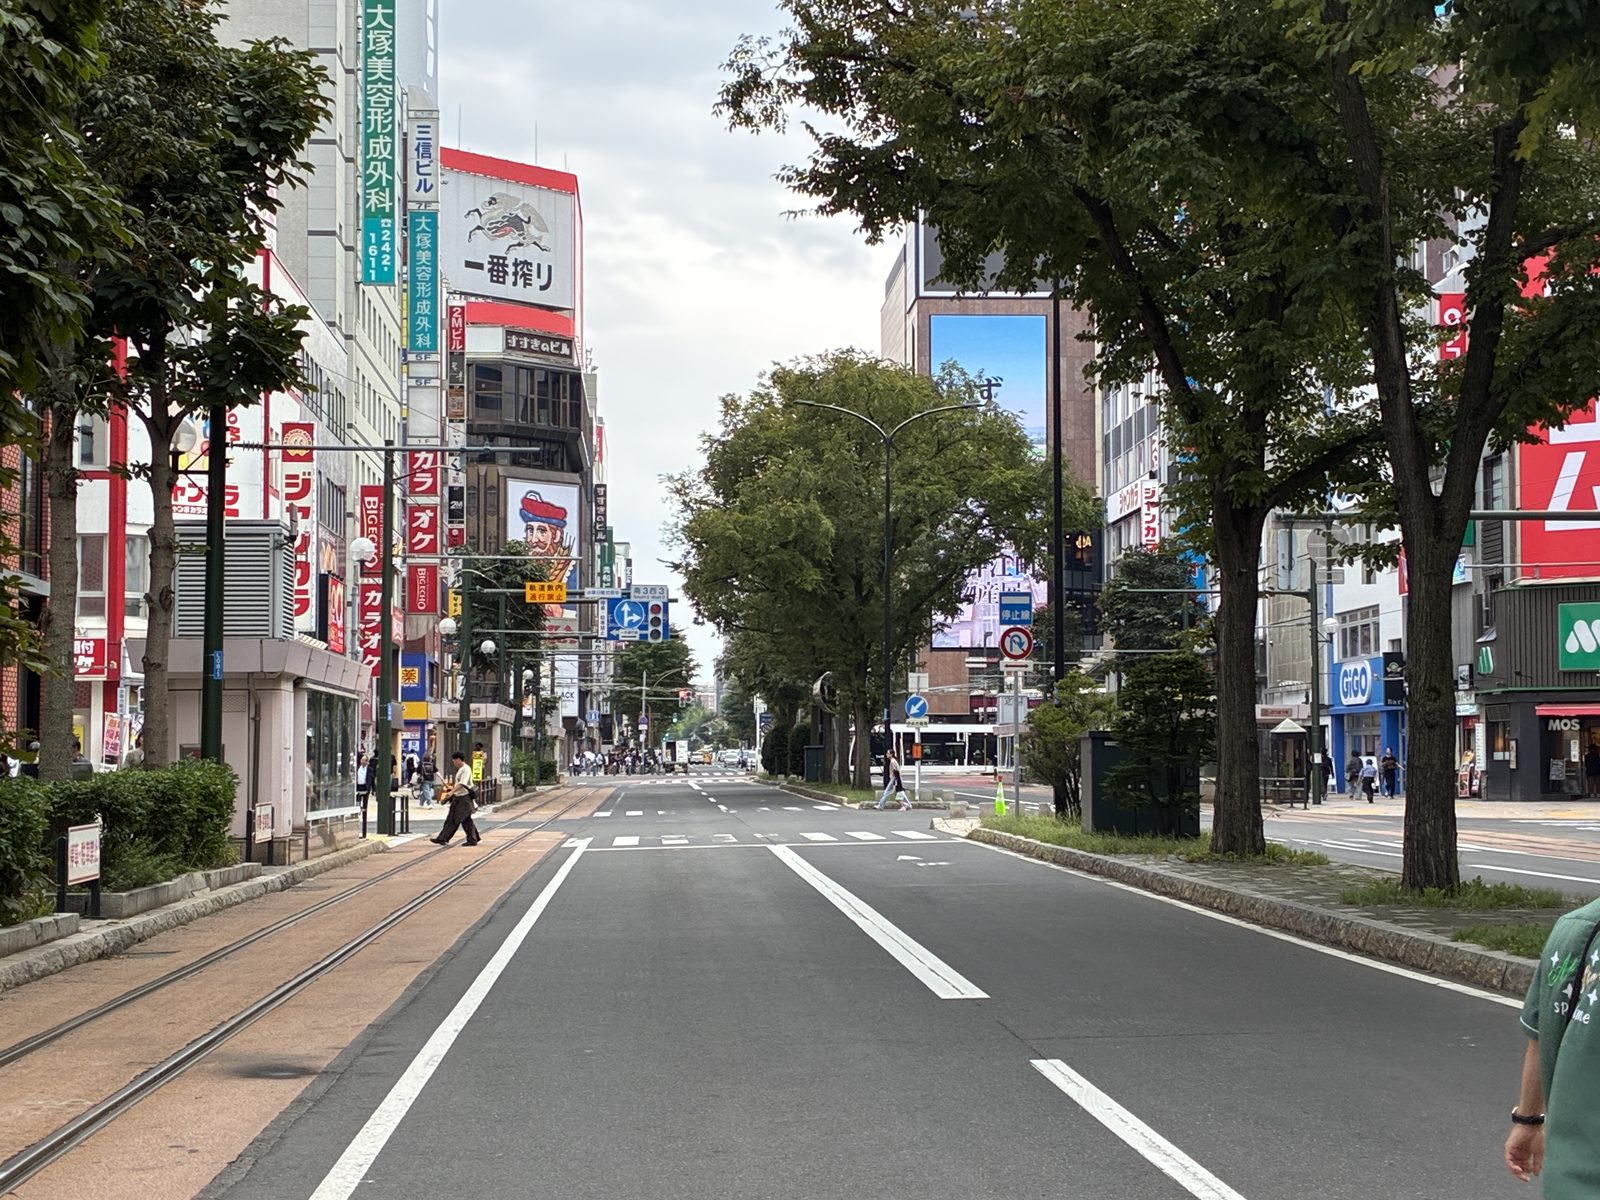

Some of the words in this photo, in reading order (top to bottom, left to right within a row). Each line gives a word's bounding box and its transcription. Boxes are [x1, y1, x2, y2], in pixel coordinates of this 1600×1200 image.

[366, 4, 393, 213] 大塚美容形成外科
[415, 124, 434, 194] 三信ビル
[415, 216, 432, 348] 大塚美容形成外科
[464, 254, 553, 292] 一番搾り
[451, 308, 463, 350] 2Mビル
[507, 335, 571, 356] すすきのビル
[364, 496, 379, 528] BIG
[411, 450, 435, 551] カラオケ
[417, 567, 427, 583] BIG
[417, 584, 427, 610] ECHO
[1001, 609, 1031, 621] 停止線
[362, 590, 384, 669] カラオケ
[1548, 718, 1581, 732] MOS
